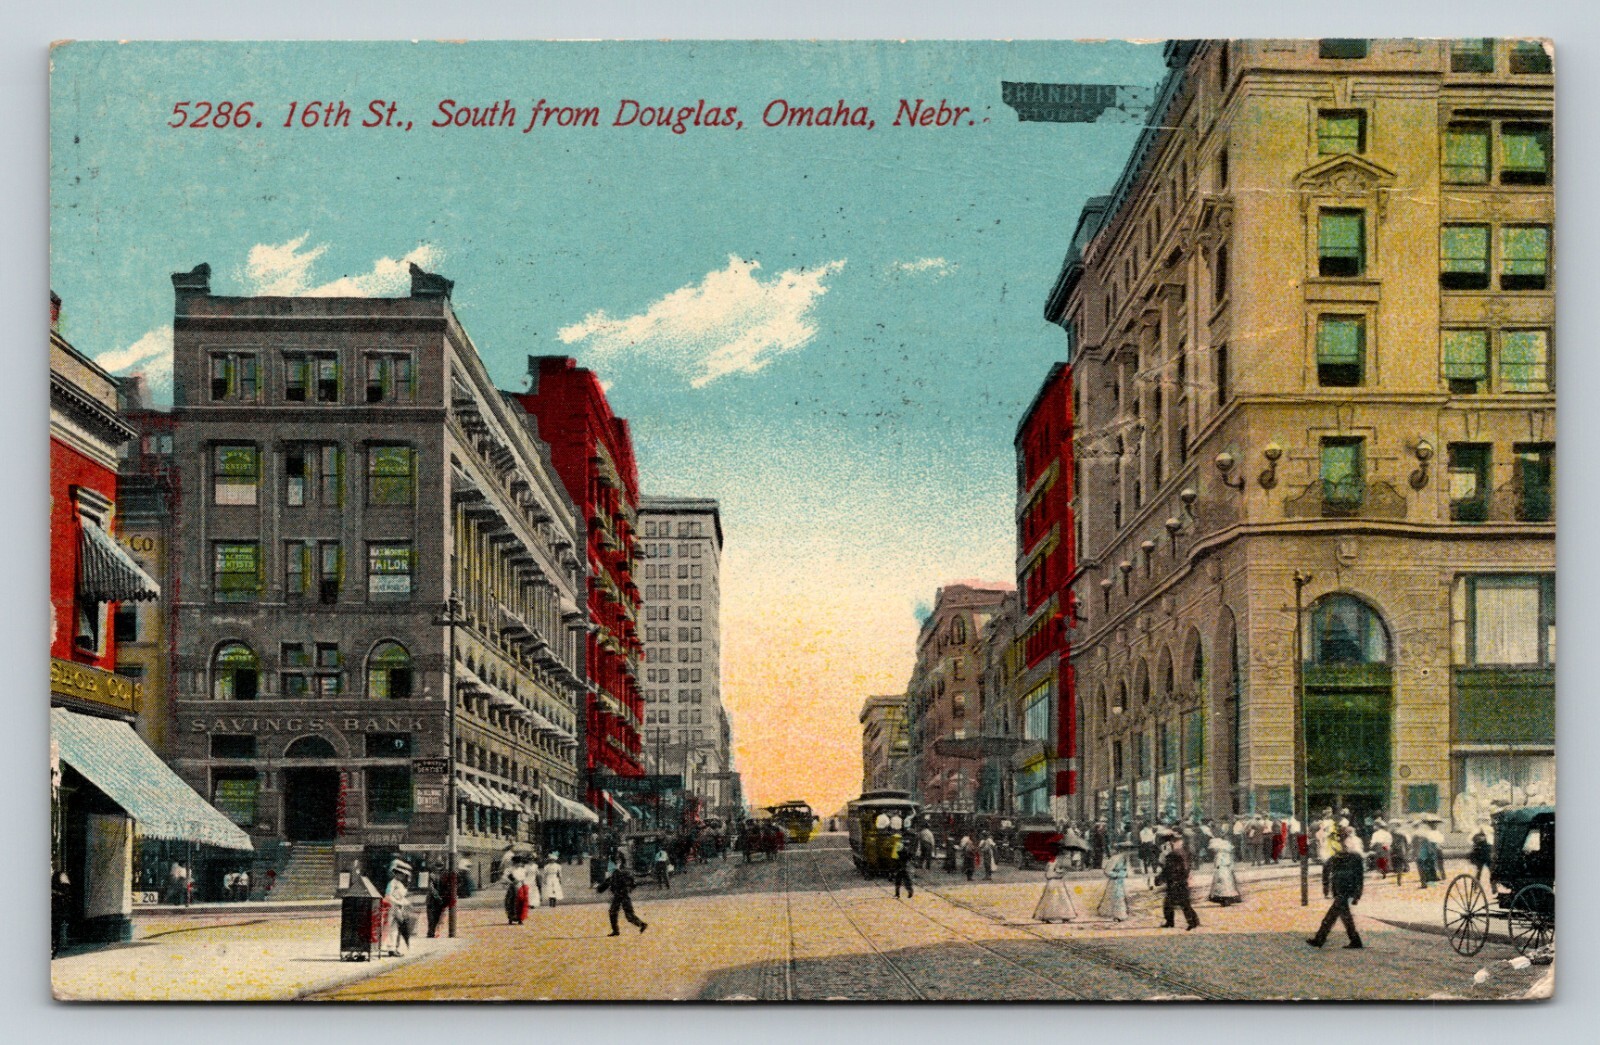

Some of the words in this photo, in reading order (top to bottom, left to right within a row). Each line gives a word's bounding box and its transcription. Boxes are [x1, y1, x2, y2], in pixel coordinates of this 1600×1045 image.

[1002, 83, 1117, 104] BRANDEIS
[370, 559, 409, 570] TAILOR
[191, 717, 326, 733] SAVINGS
[344, 717, 424, 732] BANK
